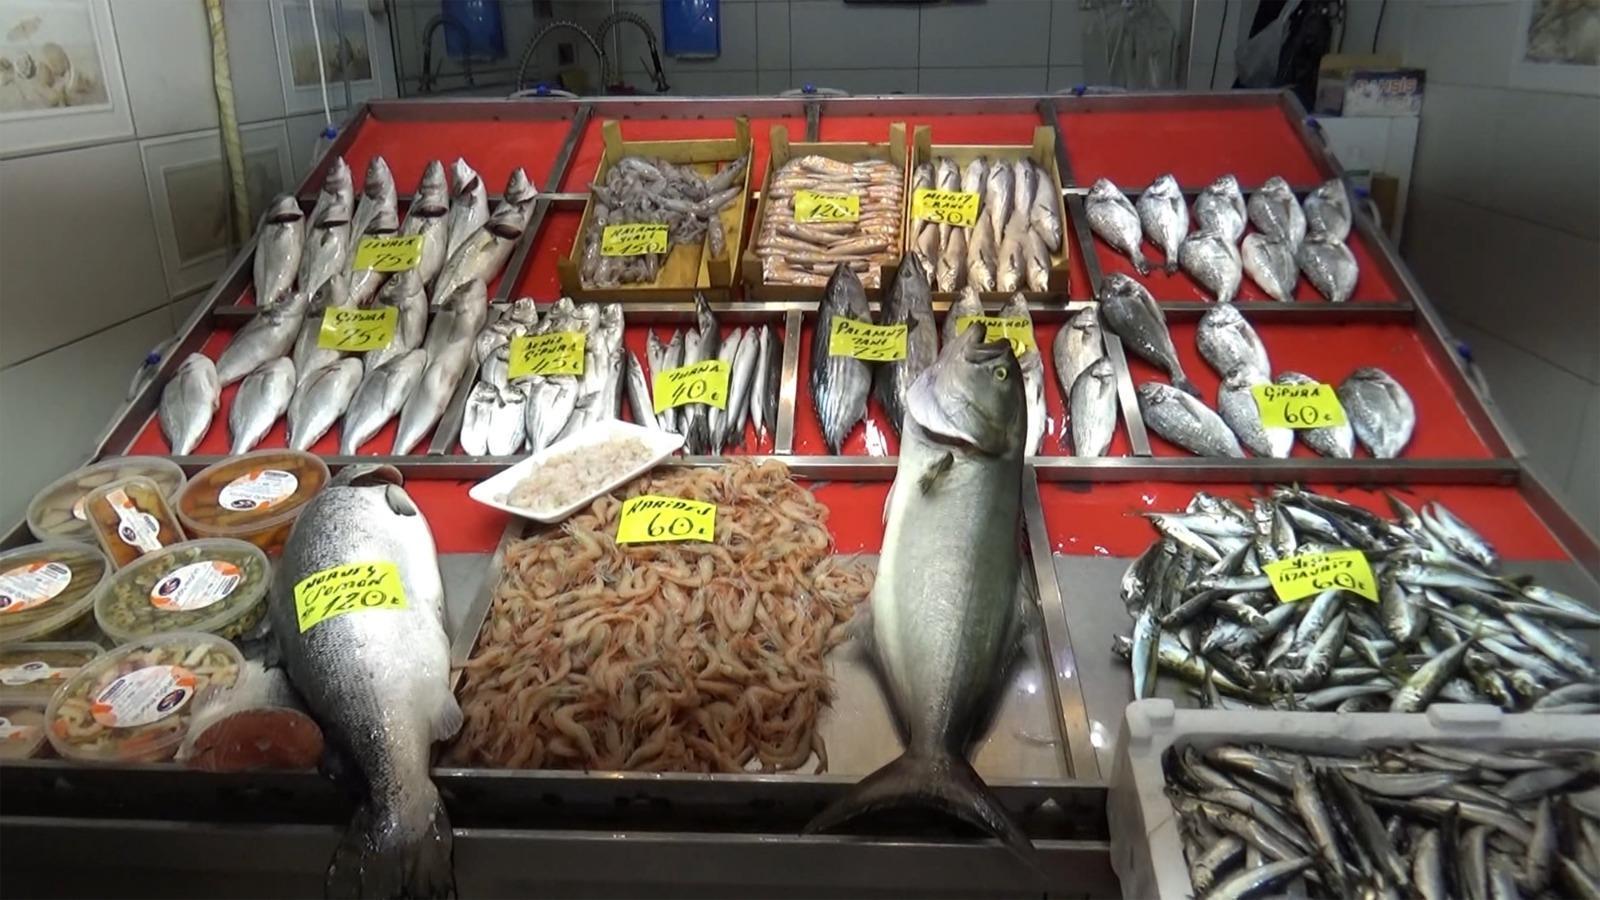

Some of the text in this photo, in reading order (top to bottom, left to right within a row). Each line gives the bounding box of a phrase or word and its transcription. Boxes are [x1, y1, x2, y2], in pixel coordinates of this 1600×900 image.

[809, 204, 850, 218] 120
[836, 321, 906, 339] PALAMUT
[1284, 401, 1319, 426] 60
[647, 512, 694, 537] 60
[1312, 572, 1356, 590] 60
[321, 590, 388, 618] 120
